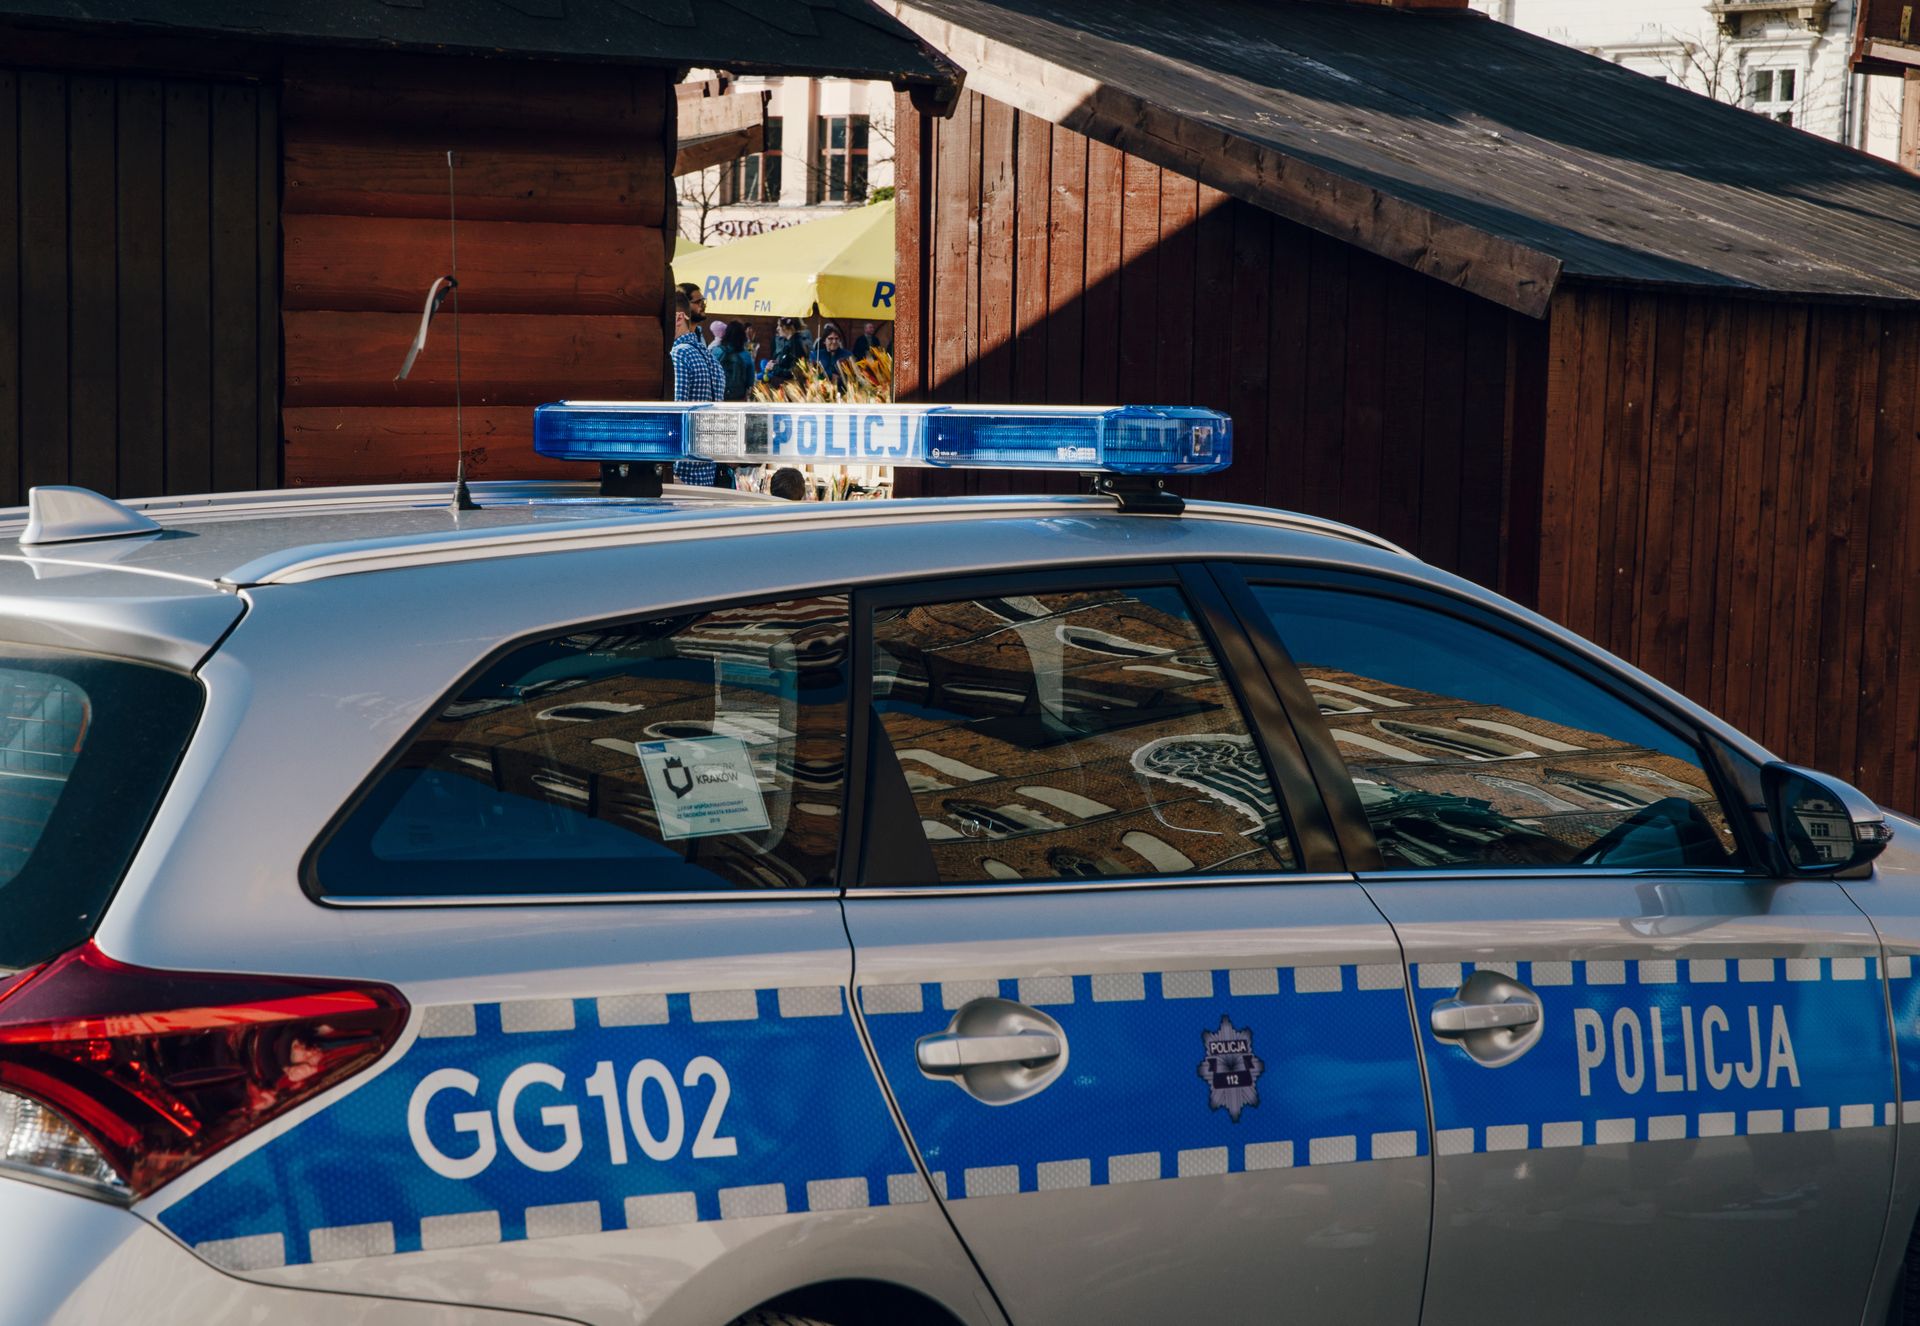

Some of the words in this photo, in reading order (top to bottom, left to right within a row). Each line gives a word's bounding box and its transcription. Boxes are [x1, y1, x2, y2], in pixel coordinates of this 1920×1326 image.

[703, 275, 760, 301] RMF
[754, 300, 771, 312] FM
[1211, 1041, 1246, 1053] POLICJA
[1574, 1004, 1800, 1096] POLICJA
[1226, 1074, 1239, 1085] 112
[407, 1055, 738, 1180] GG102
